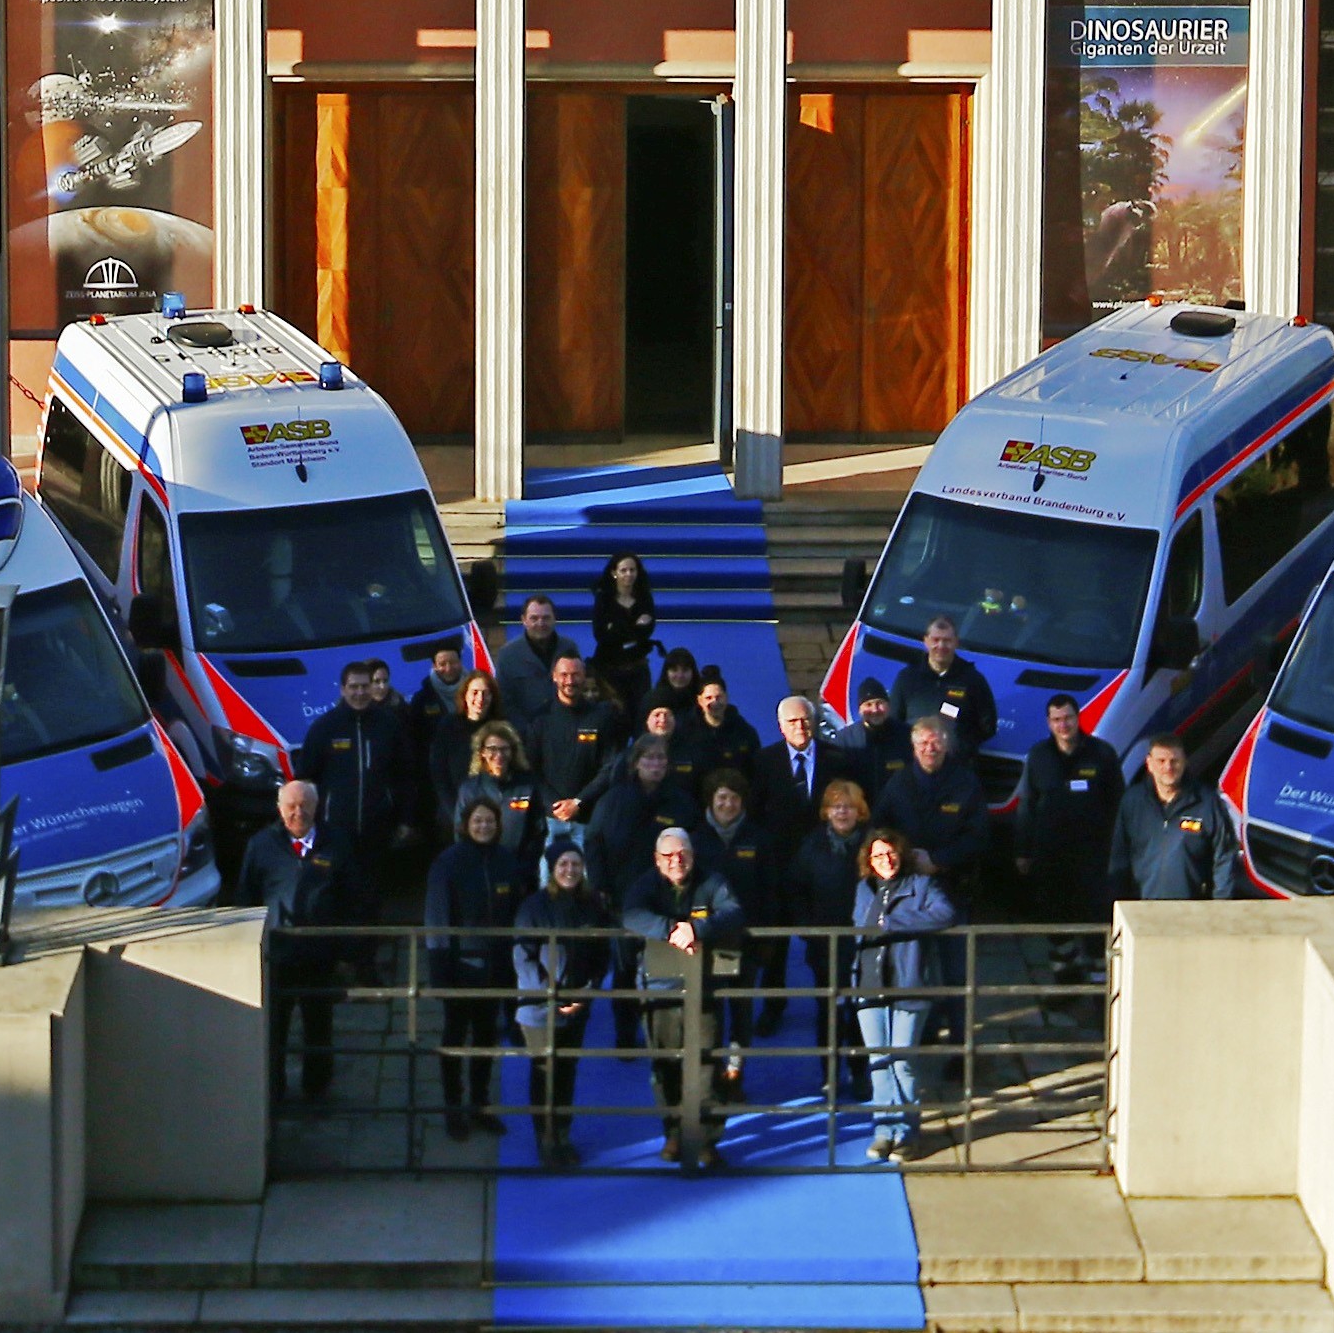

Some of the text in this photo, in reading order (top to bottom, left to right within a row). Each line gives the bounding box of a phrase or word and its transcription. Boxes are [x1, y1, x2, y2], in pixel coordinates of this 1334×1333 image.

[1070, 19, 1228, 41] DINOSAURIER
[1070, 41, 1227, 59] Giganten der Urzeit
[265, 419, 332, 443] ASB
[1020, 444, 1097, 473] ASB
[941, 484, 1031, 504] Landesverband
[1033, 496, 1104, 519] Brandenburg
[302, 705, 328, 717] Der
[1278, 781, 1307, 798] Der
